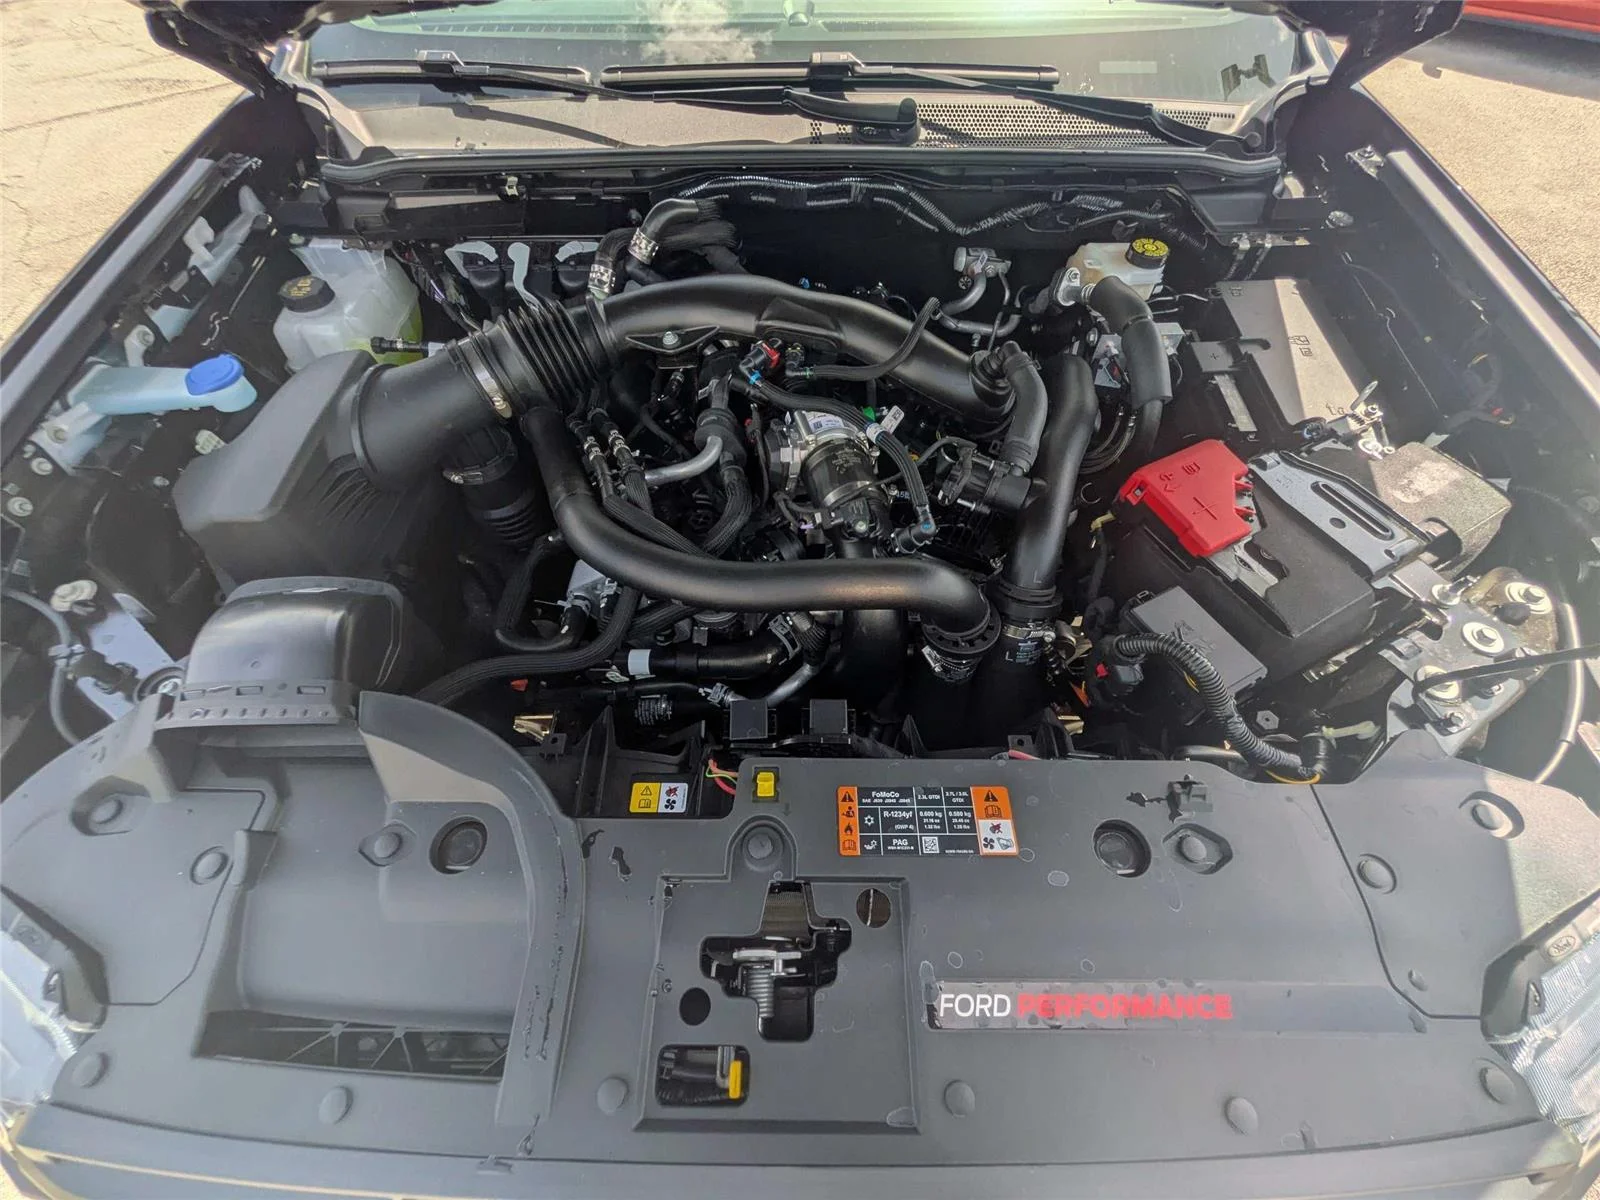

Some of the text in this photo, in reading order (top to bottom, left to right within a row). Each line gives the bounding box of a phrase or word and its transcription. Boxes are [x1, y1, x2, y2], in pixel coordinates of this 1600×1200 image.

[883, 810, 913, 819] R-1234yf
[935, 810, 943, 818] kg
[892, 838, 909, 846] PAG
[940, 993, 1233, 1019] FORD PERFORMANCE
